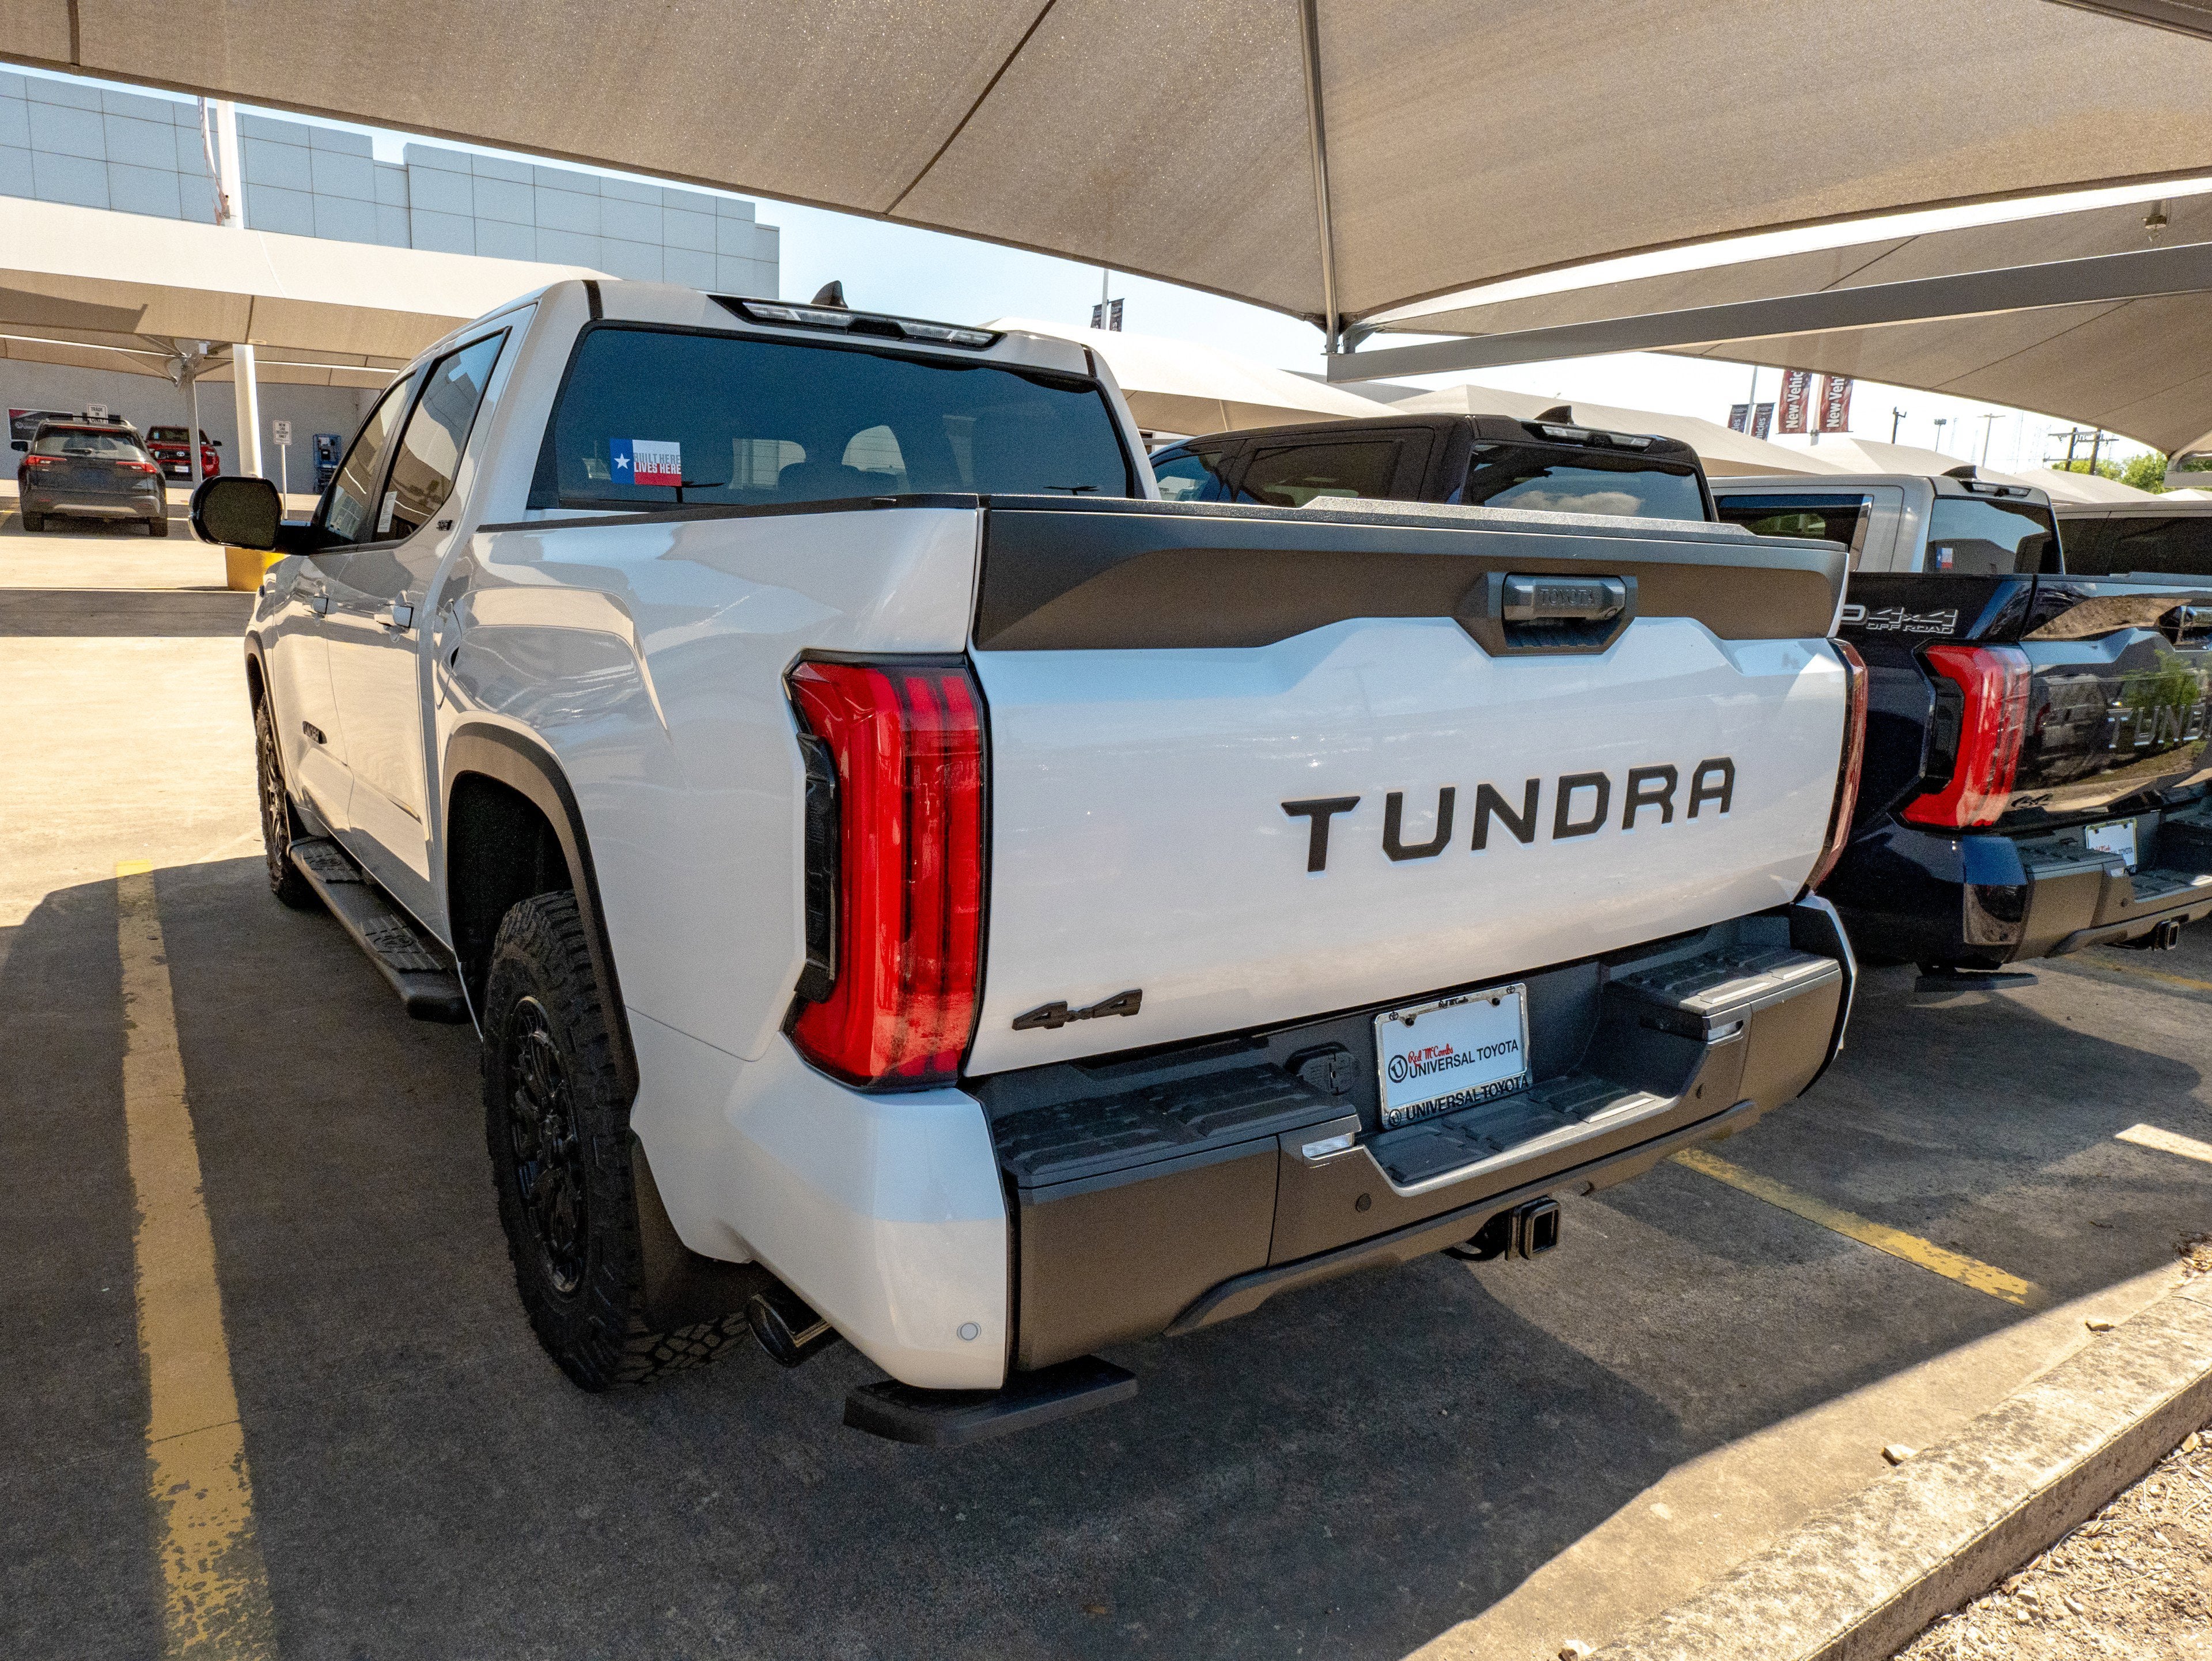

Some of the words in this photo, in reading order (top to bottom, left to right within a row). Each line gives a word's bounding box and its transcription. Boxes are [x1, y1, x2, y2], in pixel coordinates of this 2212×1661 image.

[1787, 370, 1804, 402] Vehic
[1786, 404, 1800, 428] New
[1826, 403, 1841, 427] New
[633, 452, 658, 463] BUILT
[659, 453, 681, 464] HERE
[634, 462, 658, 473] LIVES
[660, 463, 681, 474] HERE
[1540, 588, 1595, 606] TOYOTA
[1866, 622, 1901, 630] OFF
[1903, 625, 1955, 634] ROAD
[1281, 756, 1736, 873] TUNDRA
[1408, 1050, 1422, 1065] Red
[1422, 1043, 1453, 1059] McCombs
[1409, 1051, 1476, 1079] UNIVERSAL
[1476, 1039, 1519, 1061] TOYOTA
[1406, 1089, 1481, 1121] UNIVERSAL
[1481, 1075, 1529, 1098] TOYOTA
